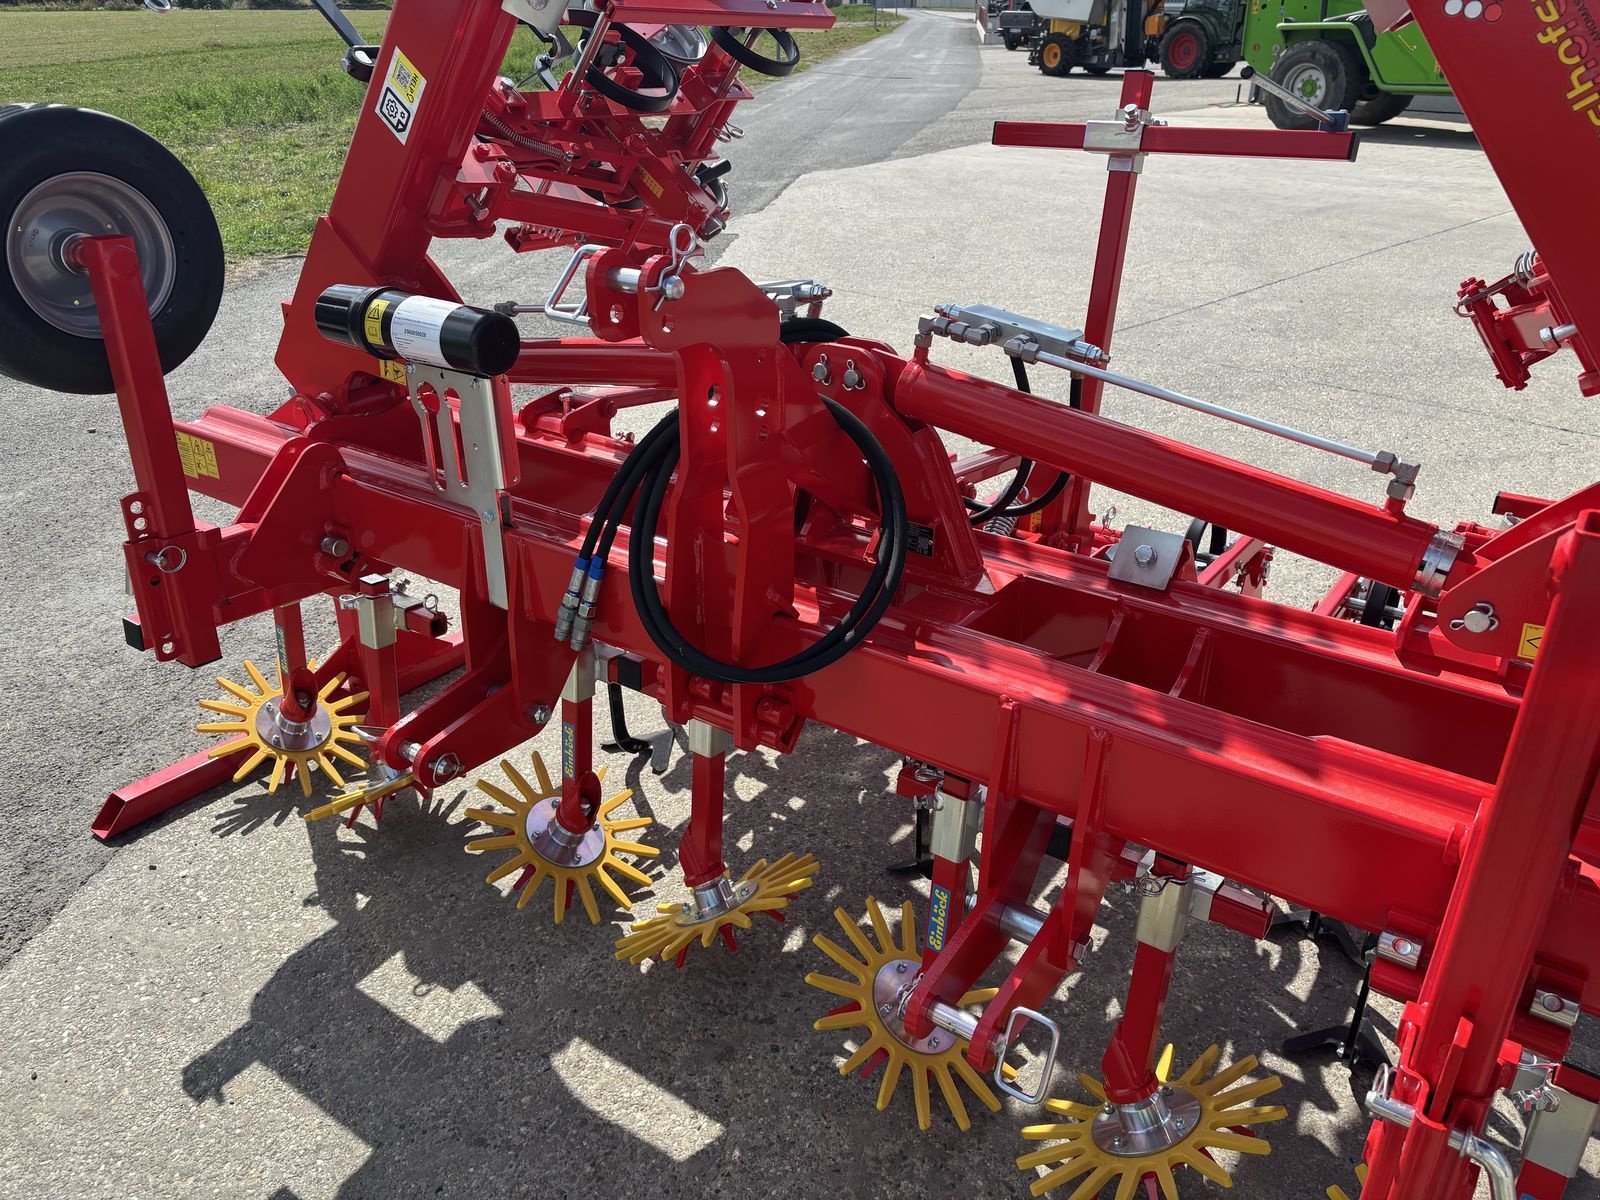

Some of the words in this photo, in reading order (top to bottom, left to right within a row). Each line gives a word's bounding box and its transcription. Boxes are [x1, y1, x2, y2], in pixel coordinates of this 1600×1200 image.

[1574, 0, 1600, 46] ANDMA
[409, 73, 419, 95] HELP
[1530, 0, 1600, 127] lhofe
[563, 725, 575, 778] Einböck
[928, 888, 948, 951] Einböck
